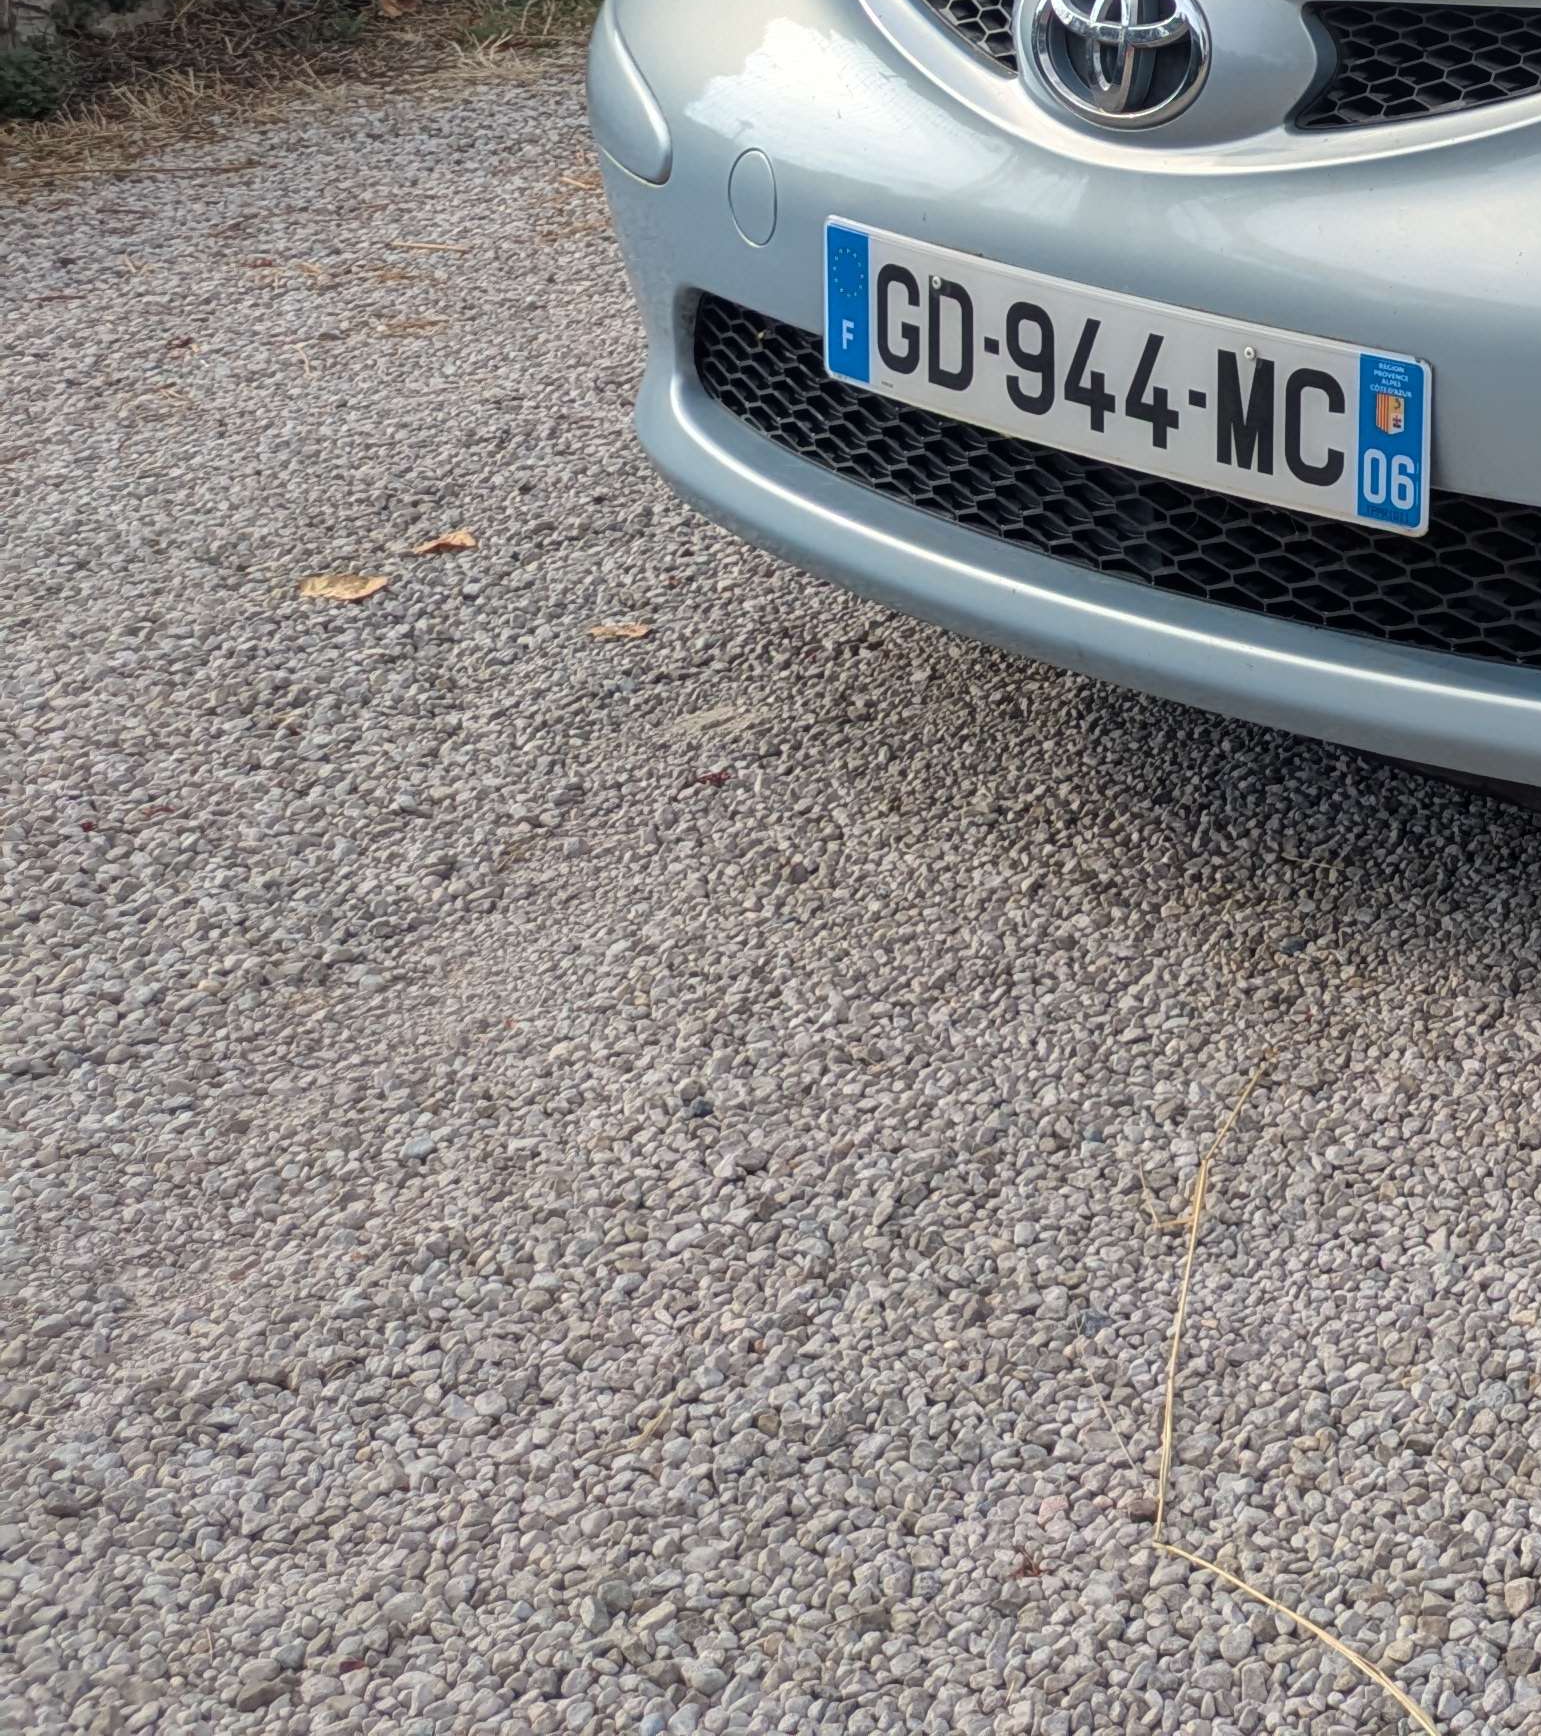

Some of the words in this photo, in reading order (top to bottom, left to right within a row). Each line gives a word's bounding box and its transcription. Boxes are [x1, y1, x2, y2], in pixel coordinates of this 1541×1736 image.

[841, 318, 855, 350] F
[876, 263, 1346, 487] GD-944-MC
[1362, 448, 1415, 511] 06
